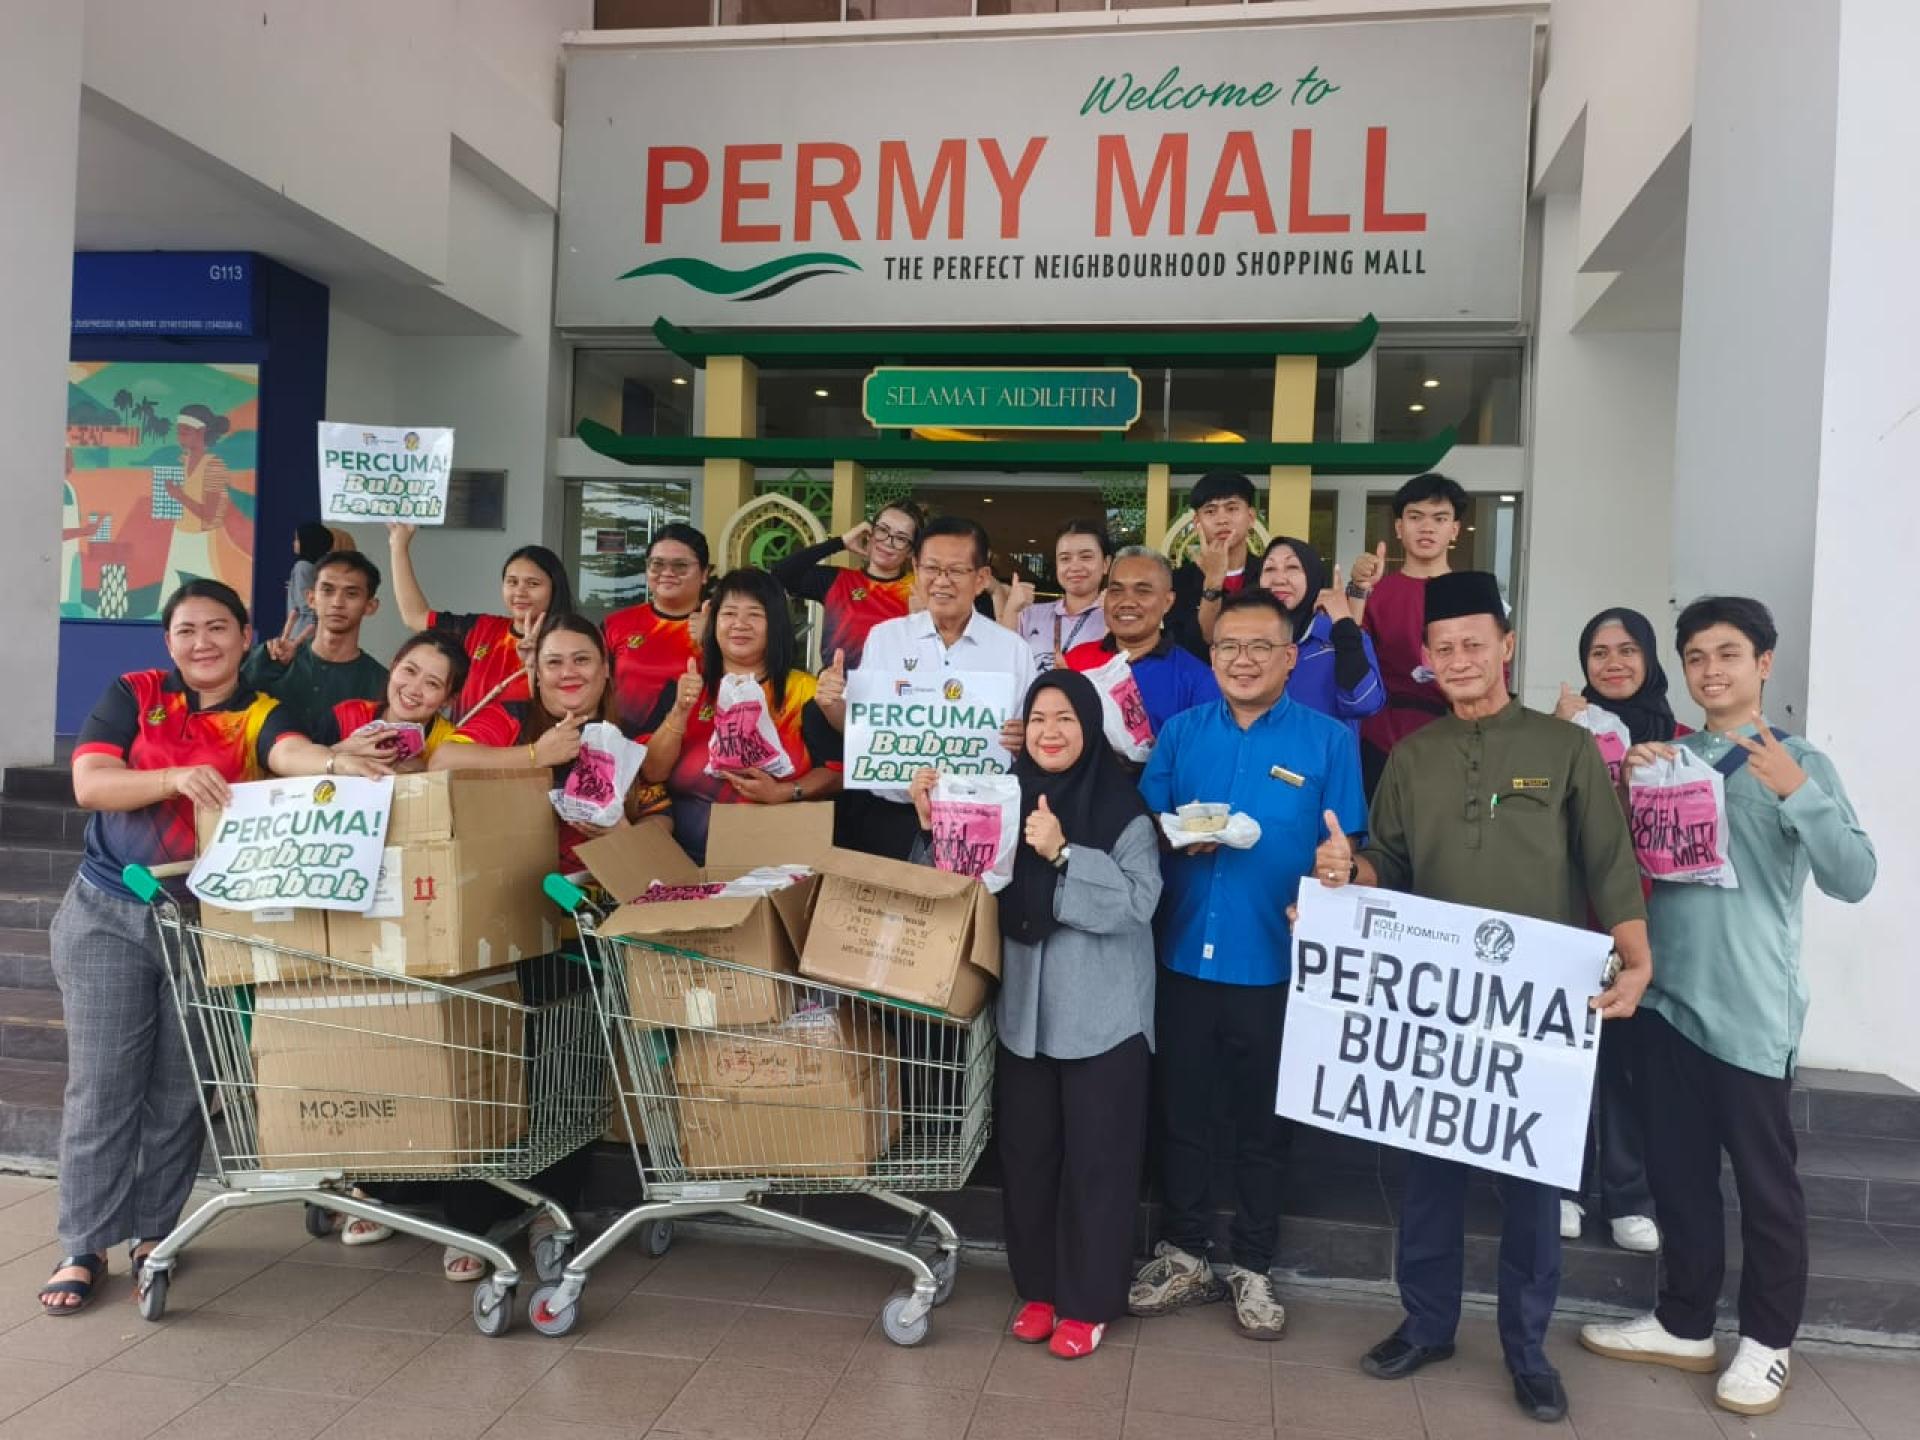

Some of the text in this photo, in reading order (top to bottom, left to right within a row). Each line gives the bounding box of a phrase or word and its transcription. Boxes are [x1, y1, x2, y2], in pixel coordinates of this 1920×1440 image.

[1079, 65, 1341, 117] Welcome to
[645, 126, 1427, 244] PERMY MALL
[208, 264, 243, 281] G113
[884, 248, 1427, 281] THE PERFECT NEIGHBOURHOOD SHOPPING MALL
[886, 386, 1116, 408] SELAMAT AIDILFITRI
[325, 449, 448, 474] PERCUMA!
[344, 473, 436, 496] Bubur
[330, 493, 442, 518] Lambuk
[851, 702, 1005, 730] PERCUMA!
[869, 730, 988, 757] Bubur
[217, 809, 382, 843] PERCUMA!
[1406, 925, 1460, 944] KOMUNITI
[1296, 938, 1596, 1050] PERCUMA!
[1338, 1009, 1524, 1099] BUBUR
[1312, 1063, 1543, 1169] LAMBUK
